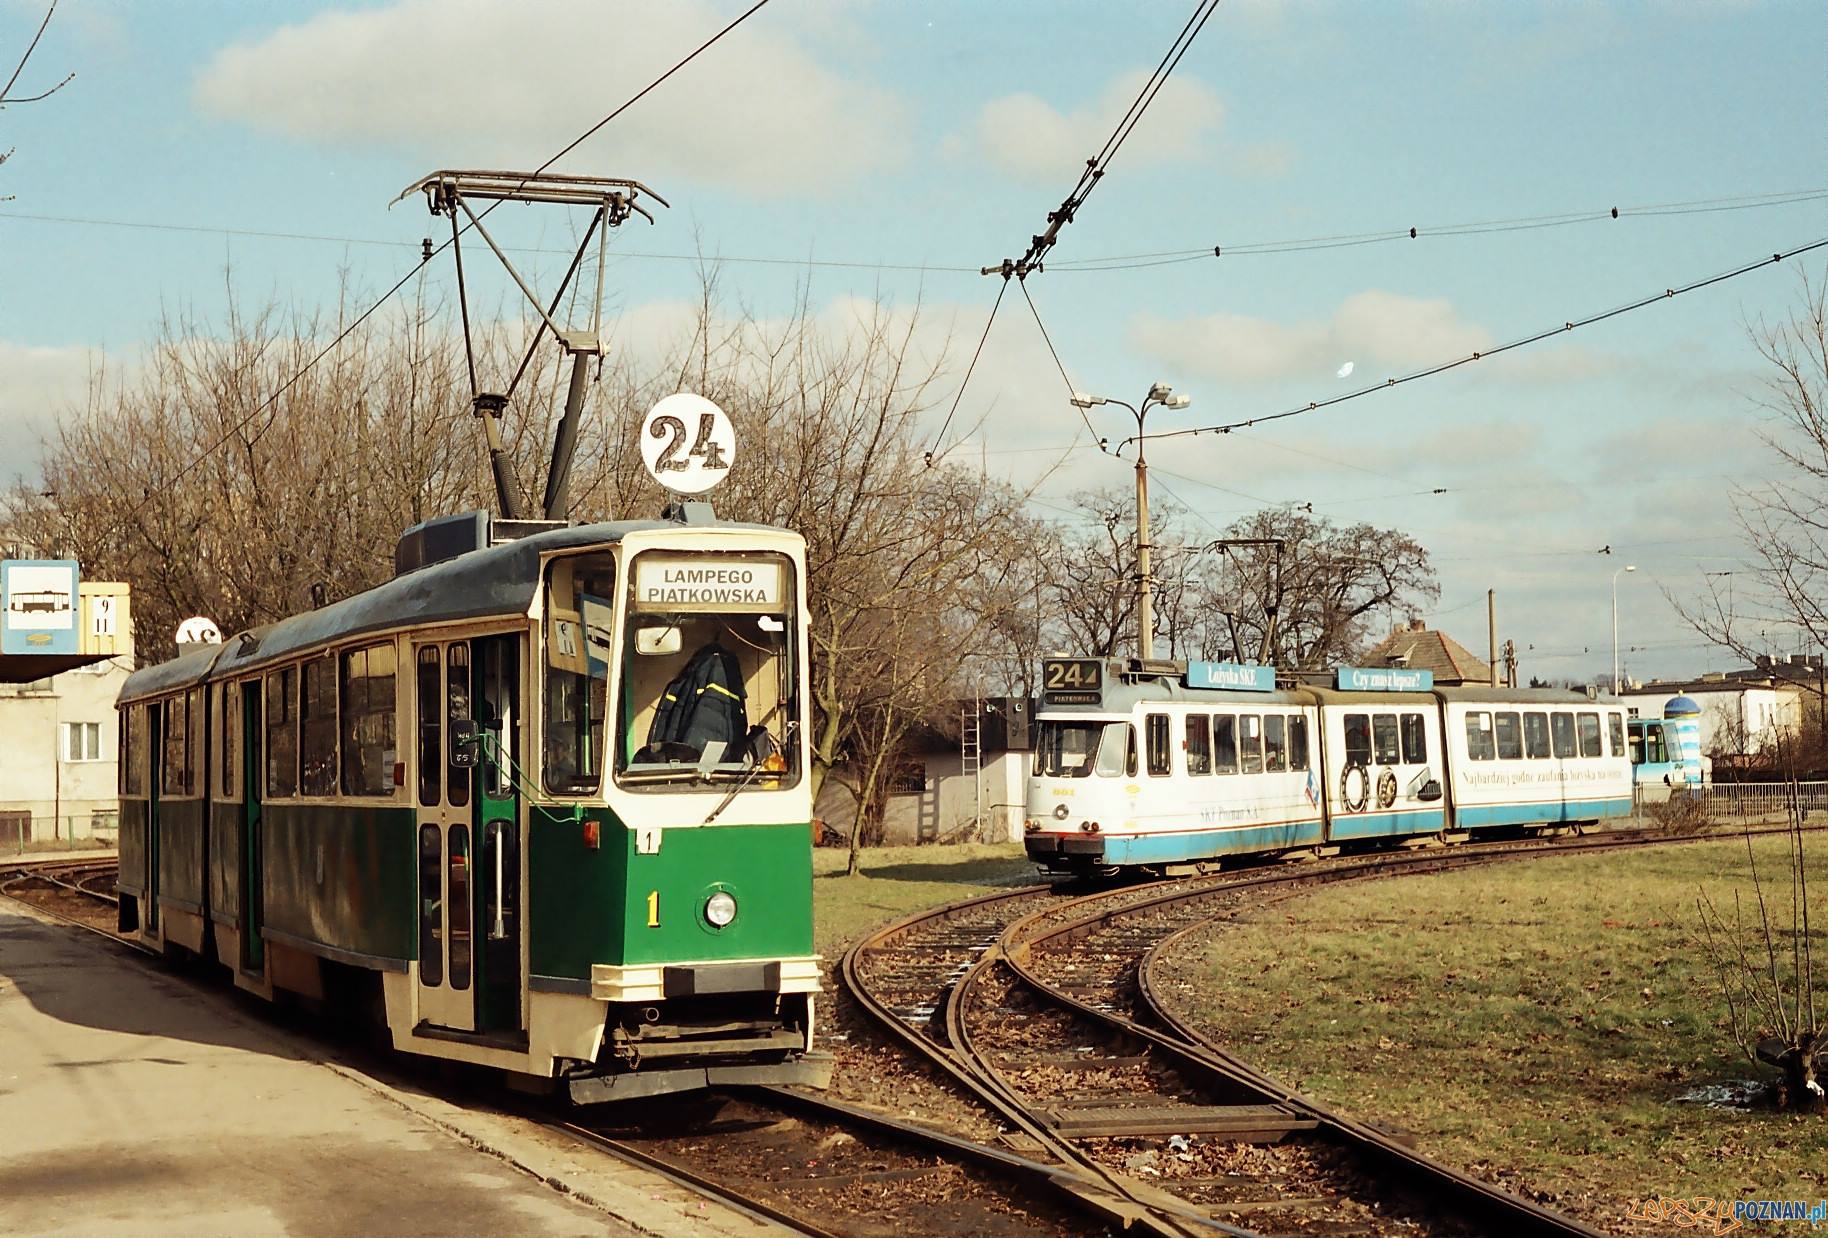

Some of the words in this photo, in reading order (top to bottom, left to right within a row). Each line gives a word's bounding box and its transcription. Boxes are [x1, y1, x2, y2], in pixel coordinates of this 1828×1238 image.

[650, 413, 728, 473] 24
[664, 569, 753, 584] LAMPEGO
[648, 588, 767, 603] PIATKOWSKA
[102, 600, 109, 613] 9
[96, 618, 107, 632] 11
[1047, 663, 1083, 688] 24
[646, 831, 652, 850] 1
[647, 890, 661, 928] 1
